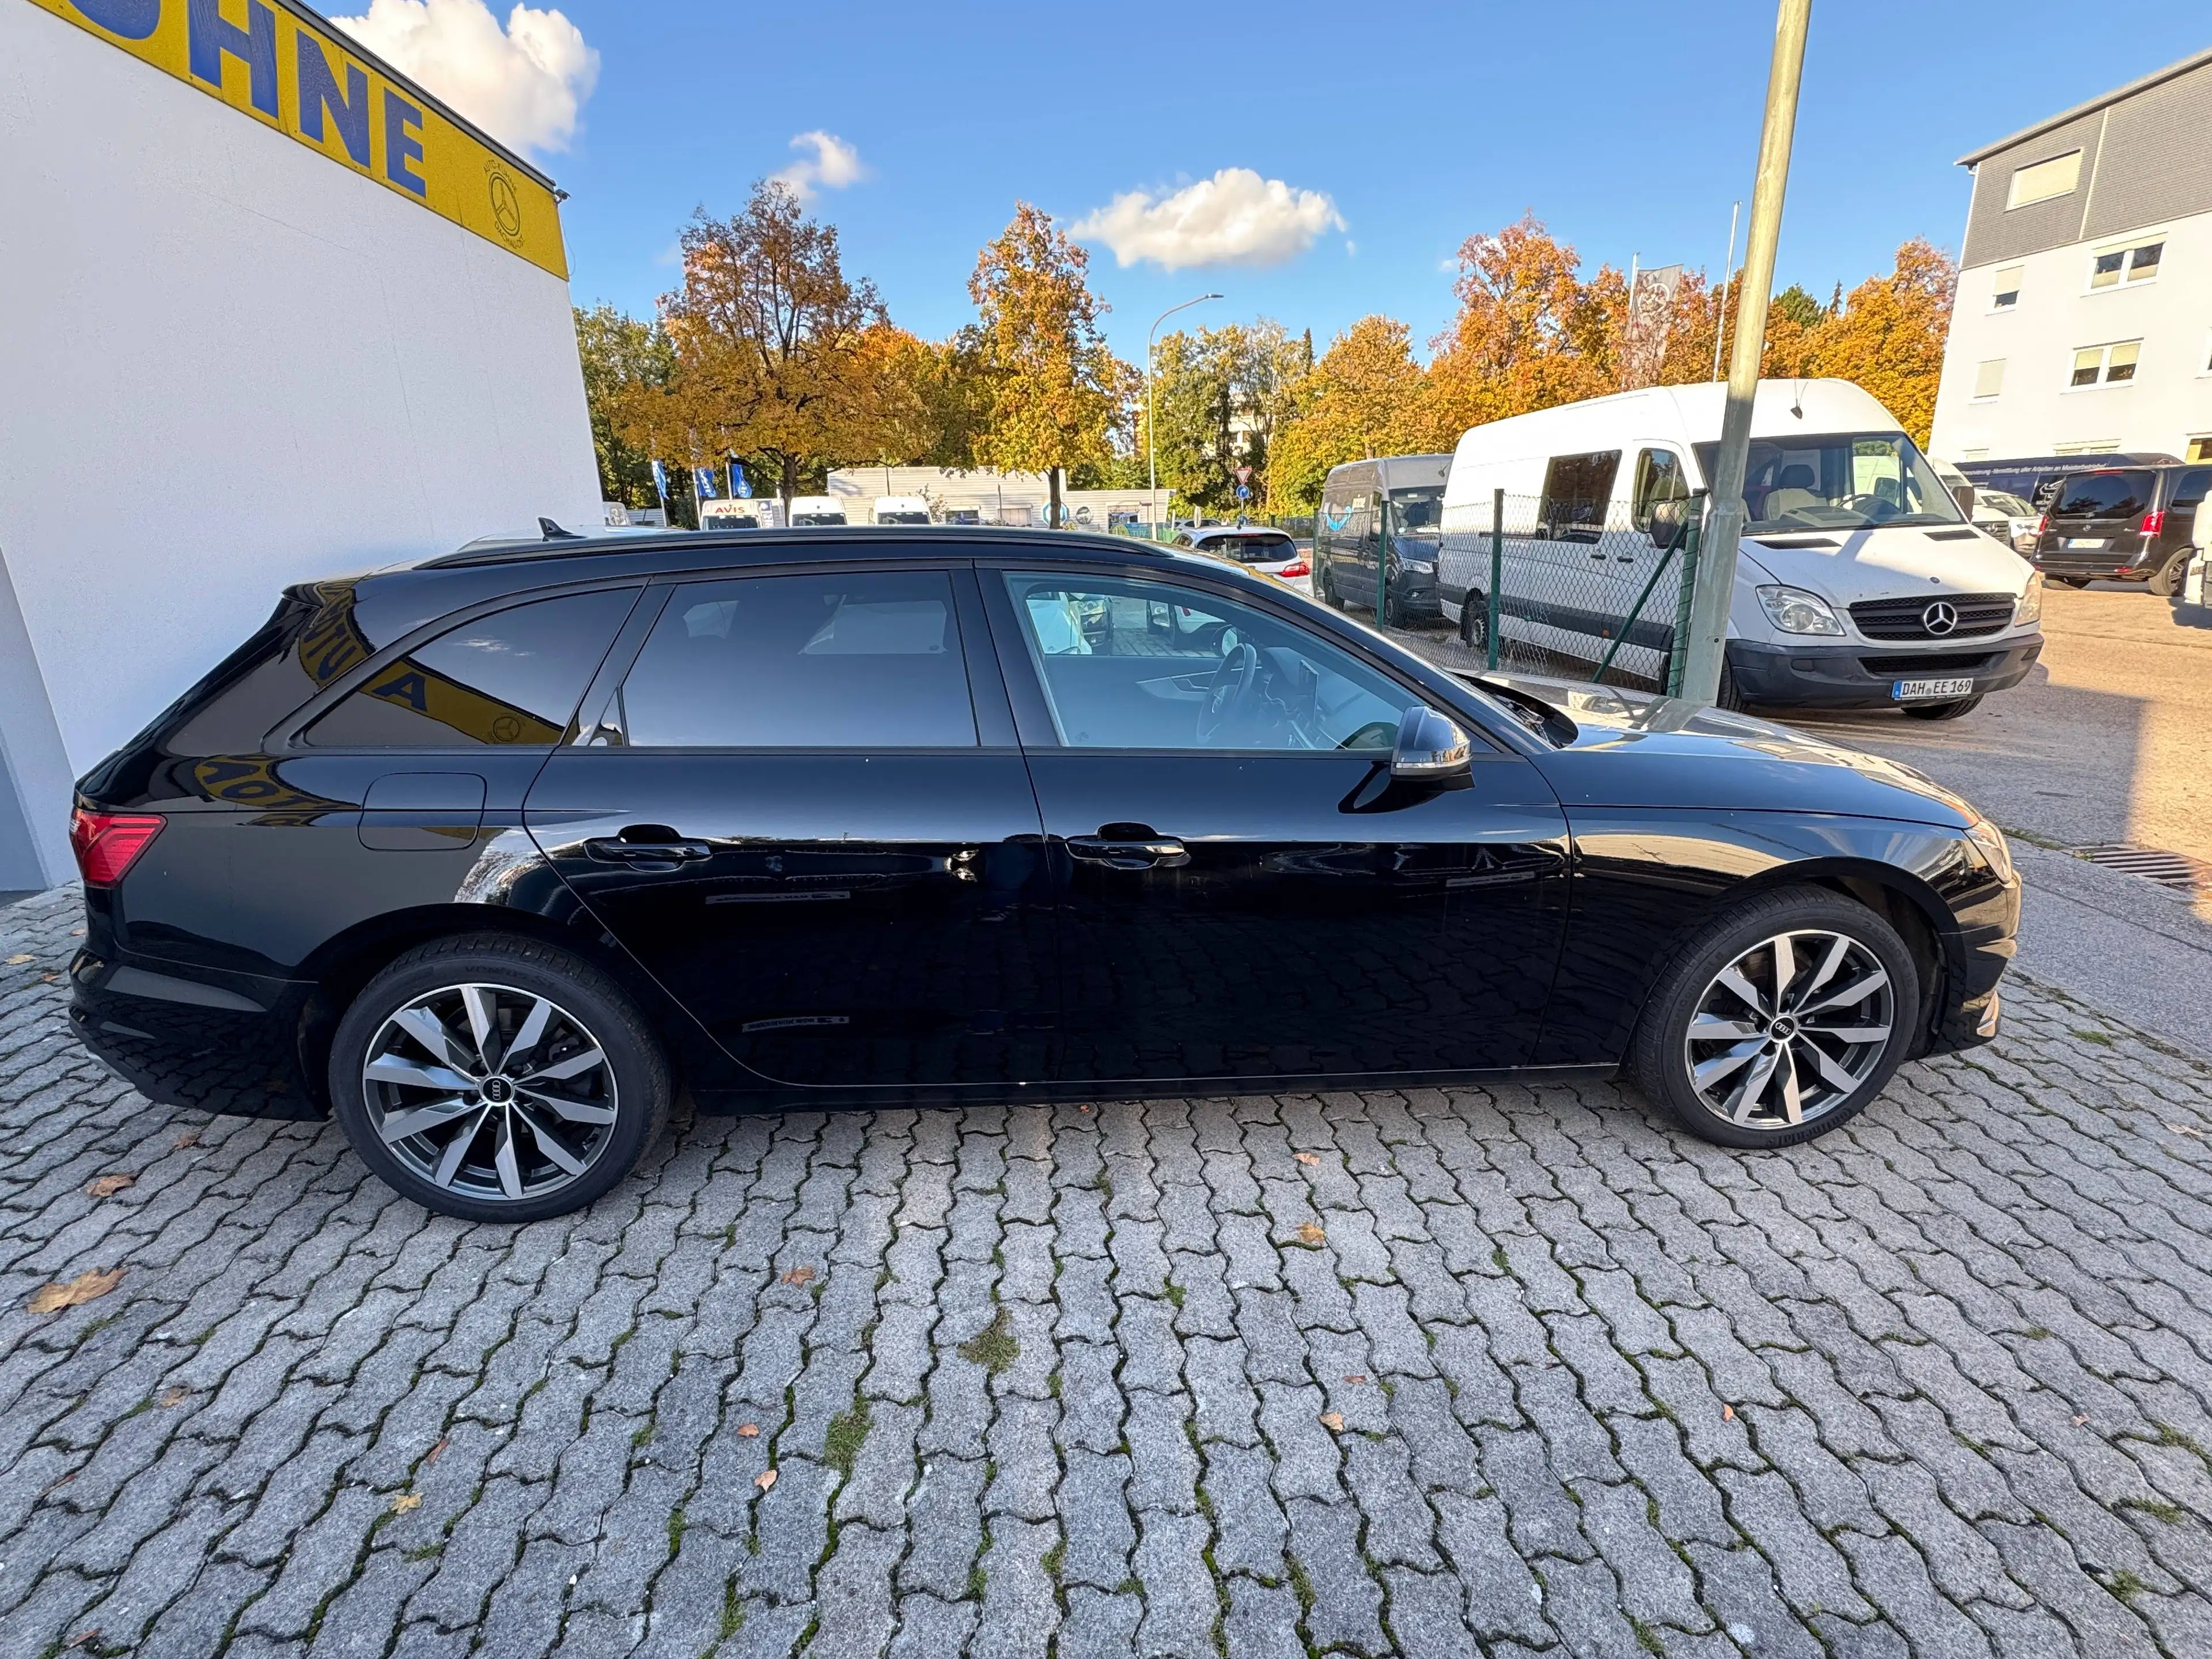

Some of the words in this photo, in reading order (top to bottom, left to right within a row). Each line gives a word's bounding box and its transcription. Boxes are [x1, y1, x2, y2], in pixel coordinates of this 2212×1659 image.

[68, 0, 427, 198] HNE
[1902, 682, 1926, 695] DAH
[1933, 681, 1948, 694] EE
[1950, 680, 1971, 693] 169
